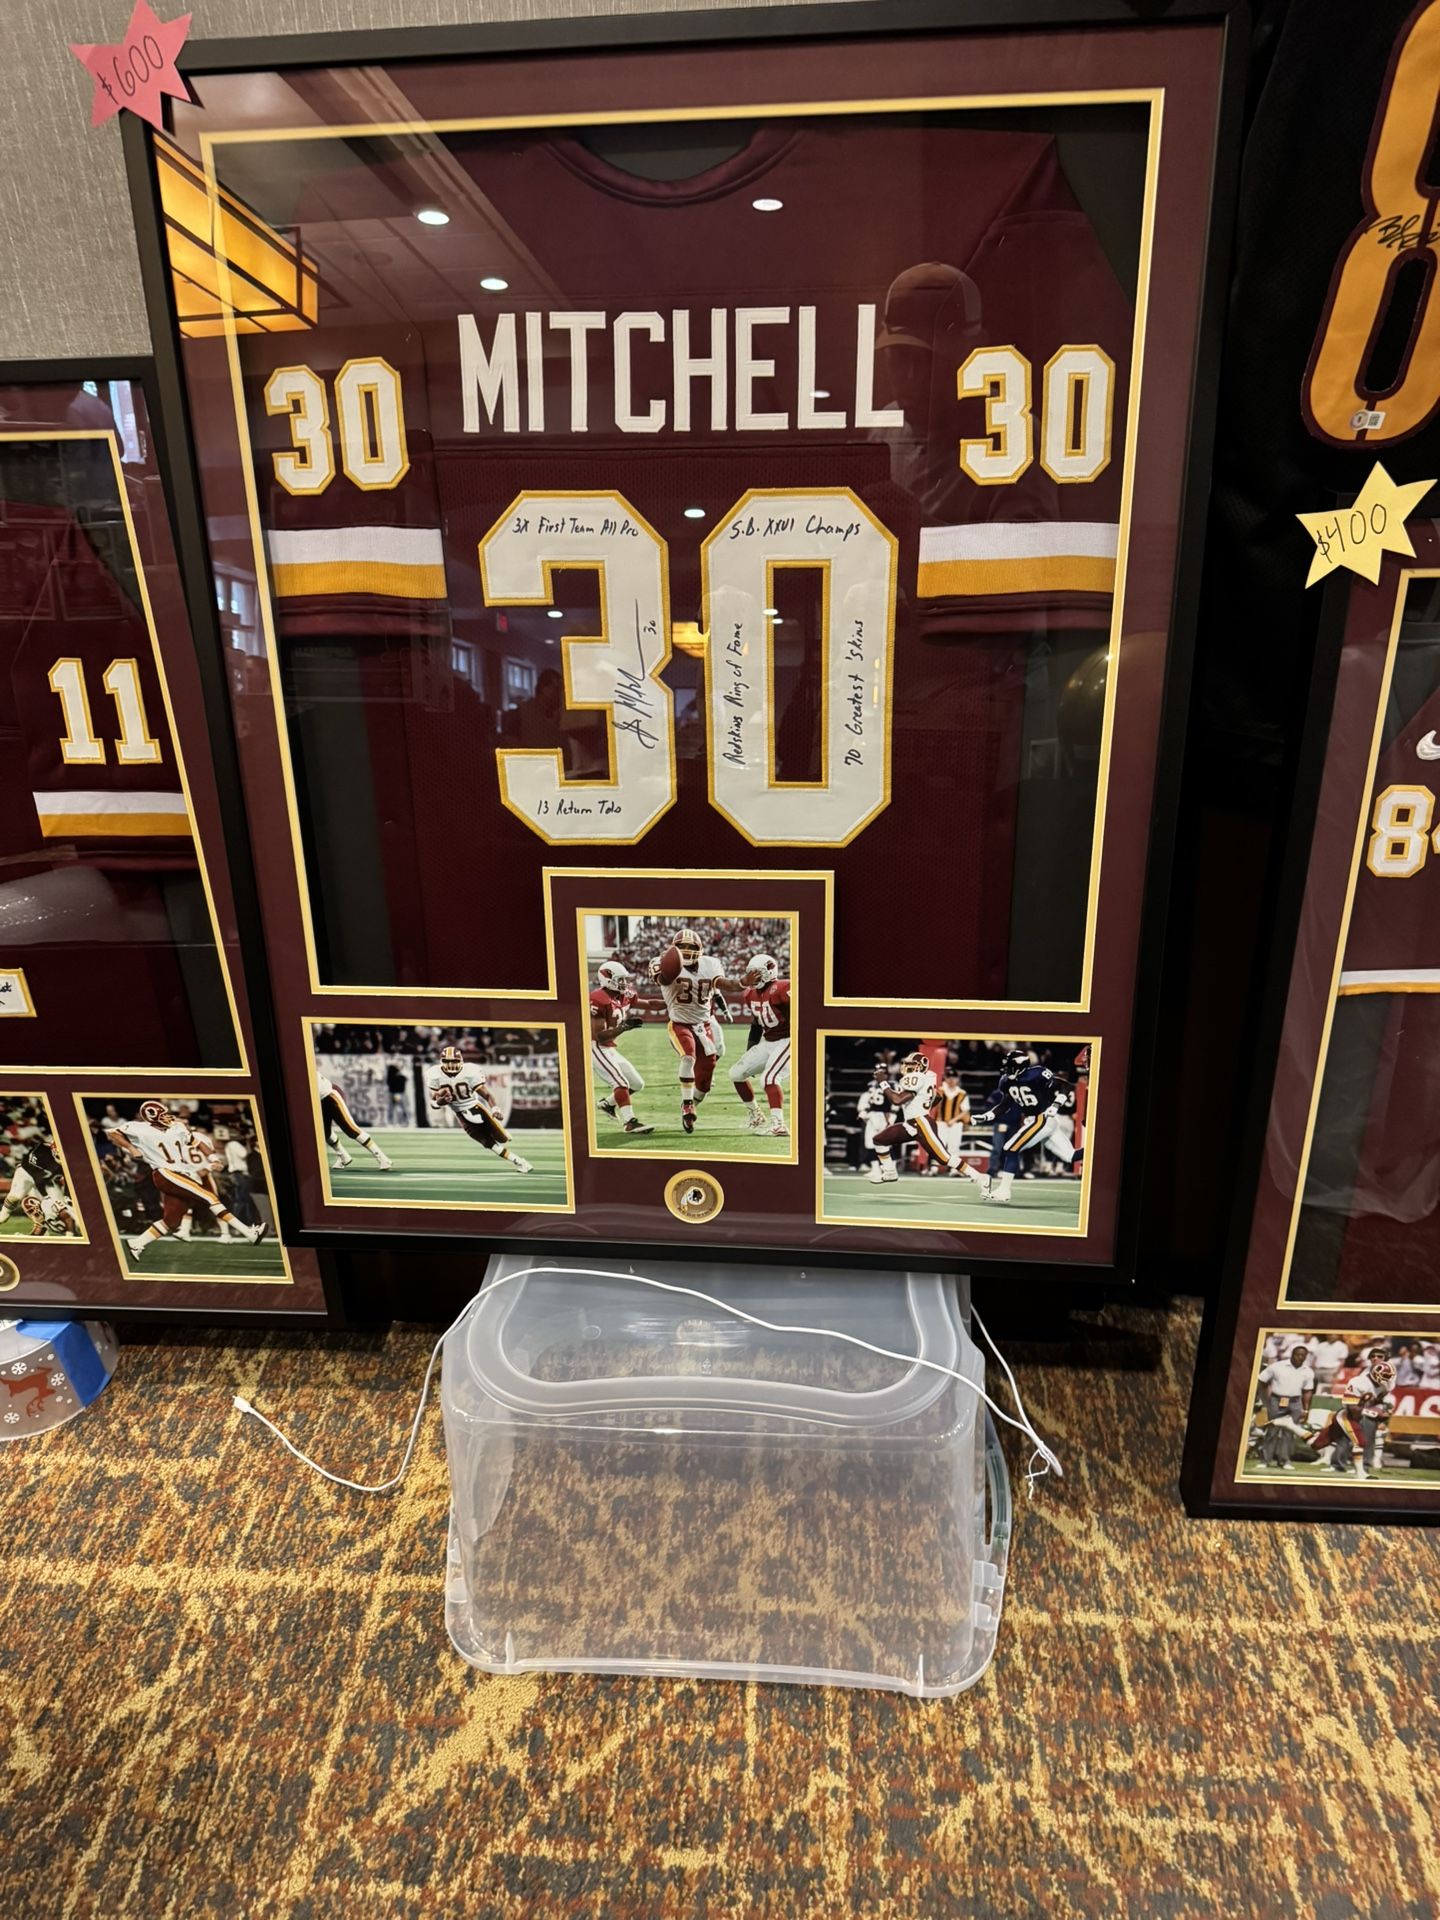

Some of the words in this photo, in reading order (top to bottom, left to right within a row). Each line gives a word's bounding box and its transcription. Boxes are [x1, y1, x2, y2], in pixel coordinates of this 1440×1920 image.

[97, 35, 164, 105] $600
[457, 304, 904, 434] MITCHELL
[264, 356, 411, 496] 30
[957, 344, 1116, 486] 30
[538, 515, 565, 534] First
[569, 517, 594, 534] Team
[600, 518, 617, 536] All
[620, 519, 639, 537] Pro
[729, 516, 760, 539] S.B.
[805, 515, 861, 542] Champs
[1316, 503, 1387, 564] $400
[478, 487, 899, 848] 30
[723, 681, 750, 708] Ring
[726, 659, 743, 678] of
[47, 657, 163, 766] 11
[844, 673, 865, 736] Greatest
[722, 715, 747, 766] Redskins
[537, 799, 549, 815] 13
[556, 798, 593, 816] Return
[1366, 784, 1440, 878] 8
[903, 1075, 918, 1086] 30
[1008, 1085, 1038, 1107] 86
